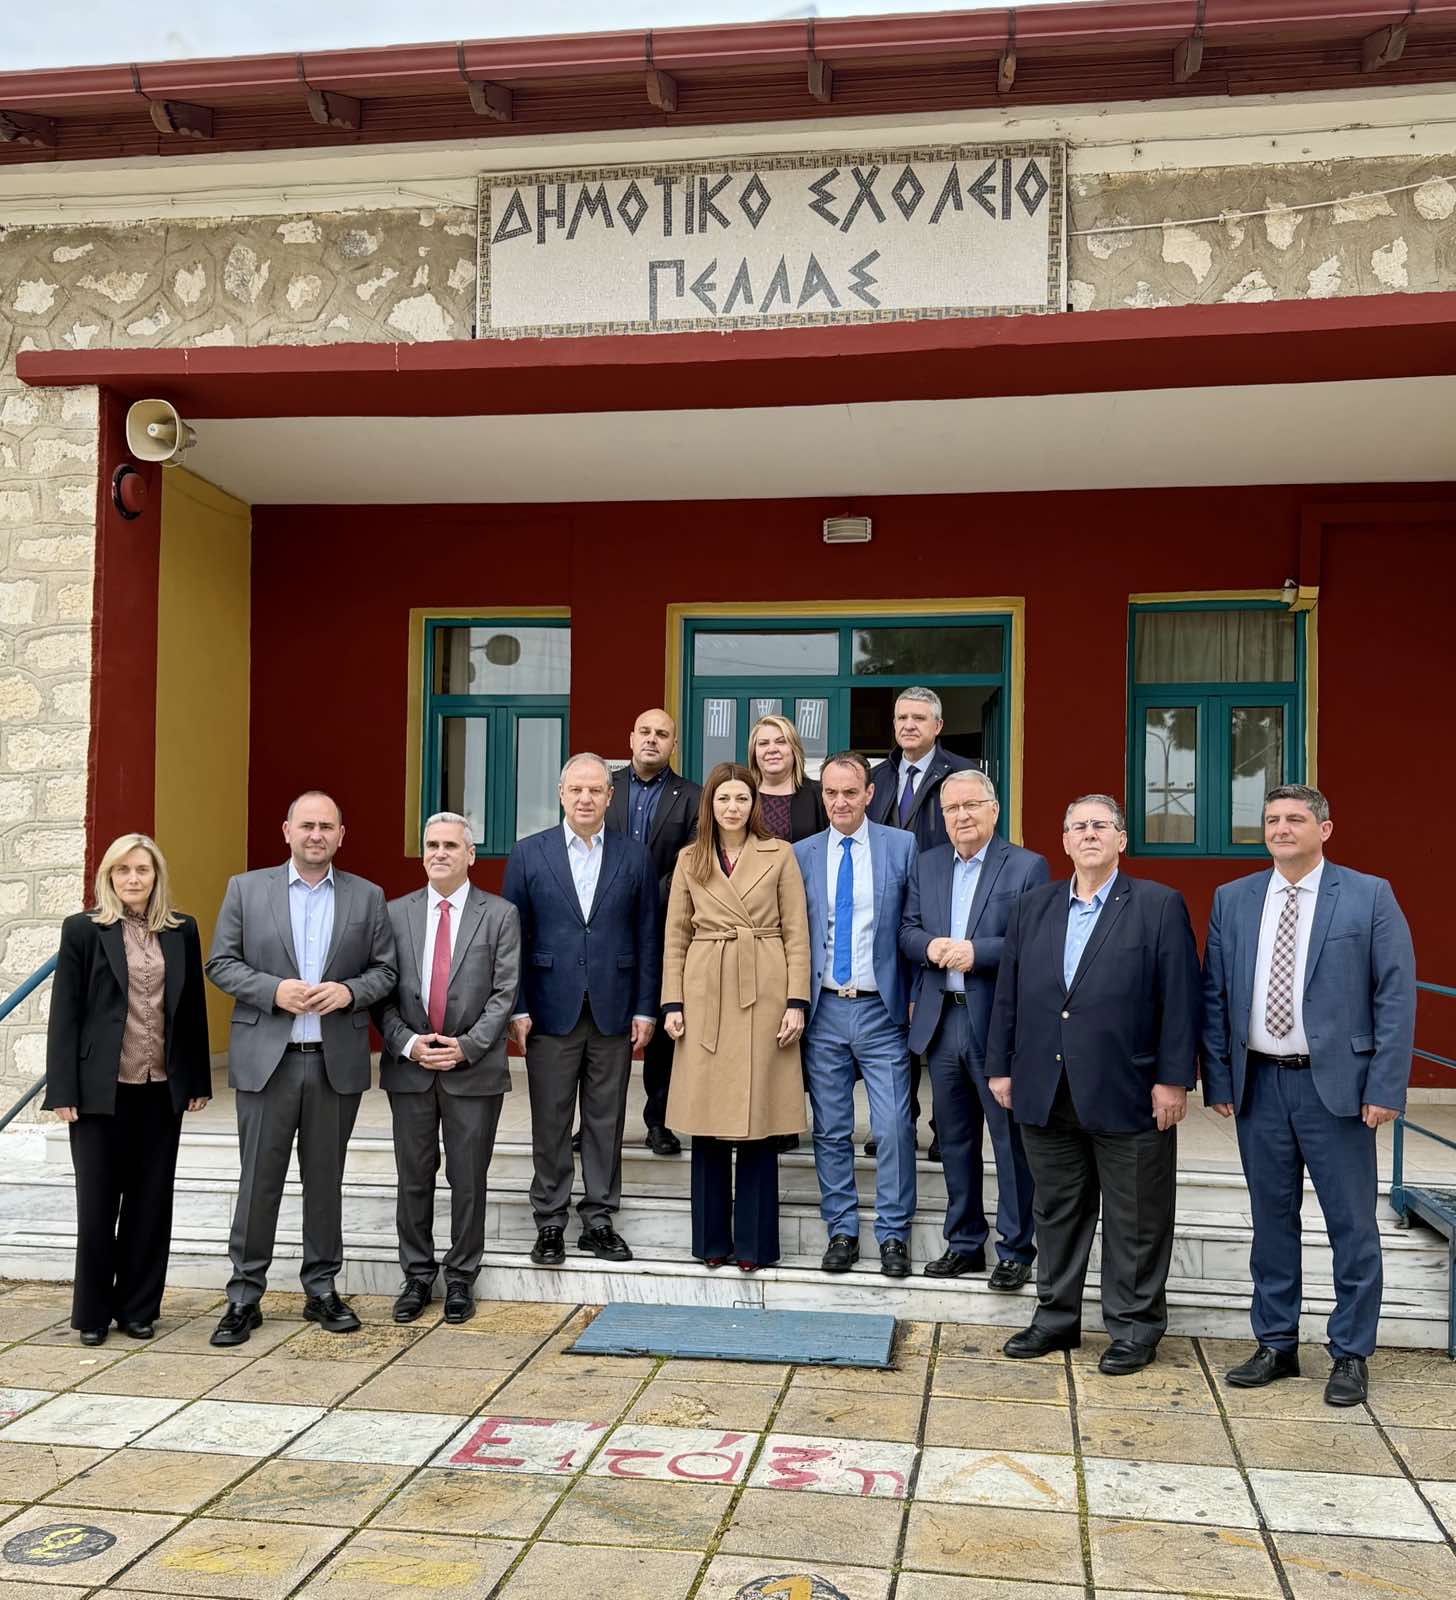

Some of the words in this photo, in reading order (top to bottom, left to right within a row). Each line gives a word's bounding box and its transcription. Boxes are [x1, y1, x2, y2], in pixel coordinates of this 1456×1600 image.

[491, 170, 772, 245] ΔΗΜΟΤΙΚΟ
[807, 157, 1050, 233] ΣΧΟΛΕΙΟ
[648, 248, 881, 320] ΠΕΛΛΑΣ
